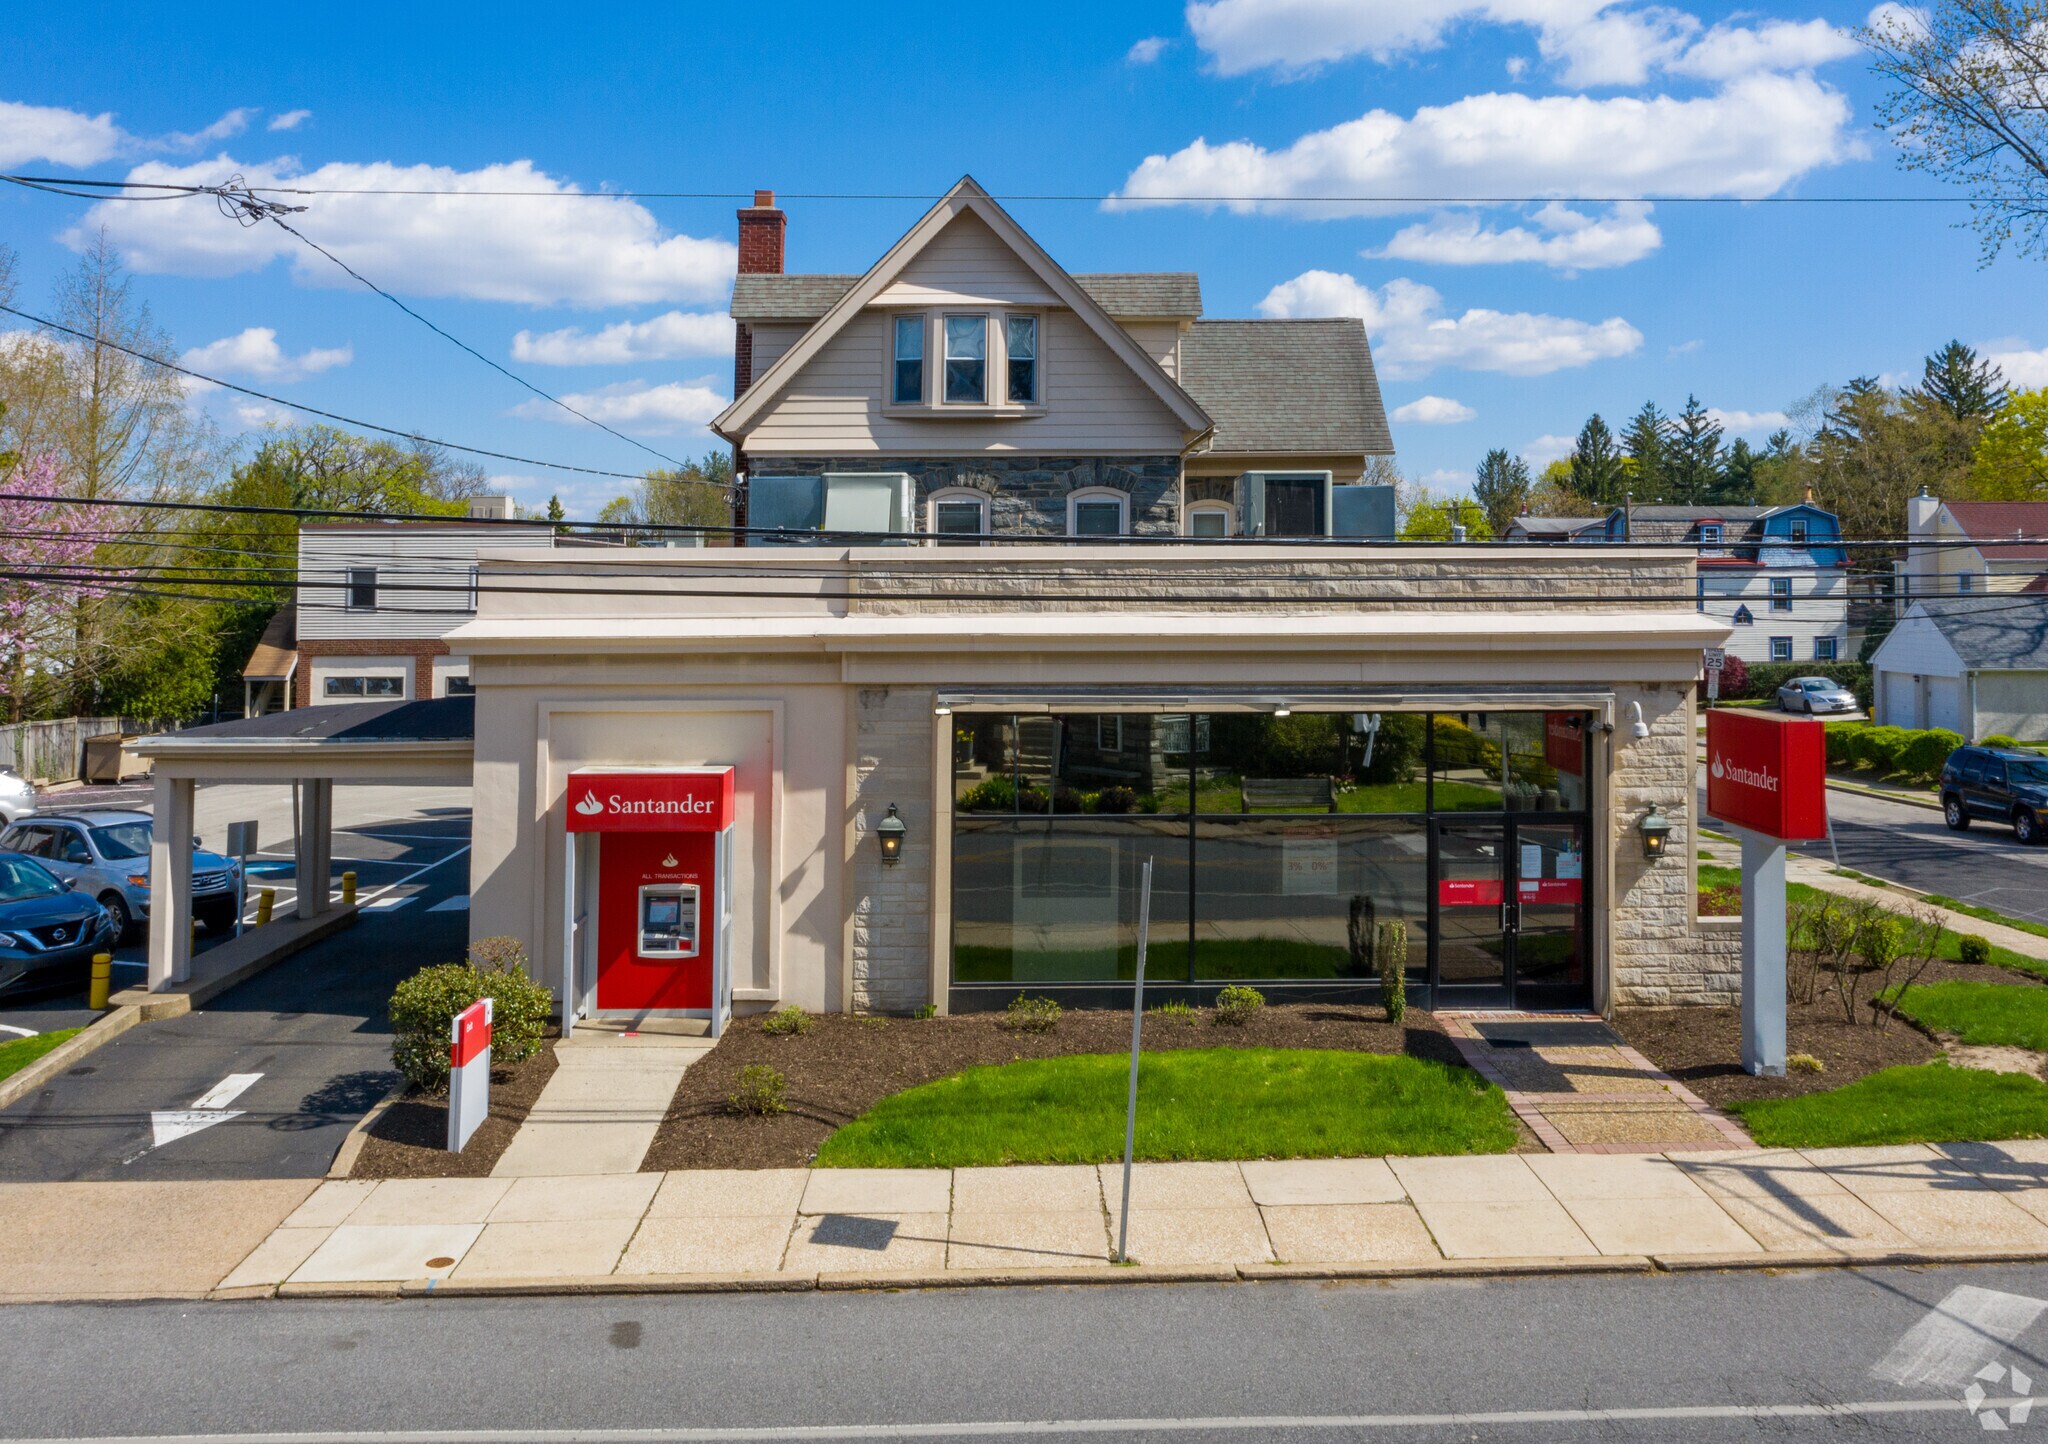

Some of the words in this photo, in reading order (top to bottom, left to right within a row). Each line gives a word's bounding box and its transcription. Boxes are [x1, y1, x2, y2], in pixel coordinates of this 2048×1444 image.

[1707, 658, 1722, 667] 25
[1725, 758, 1778, 792] Santander
[608, 794, 714, 814] Santander
